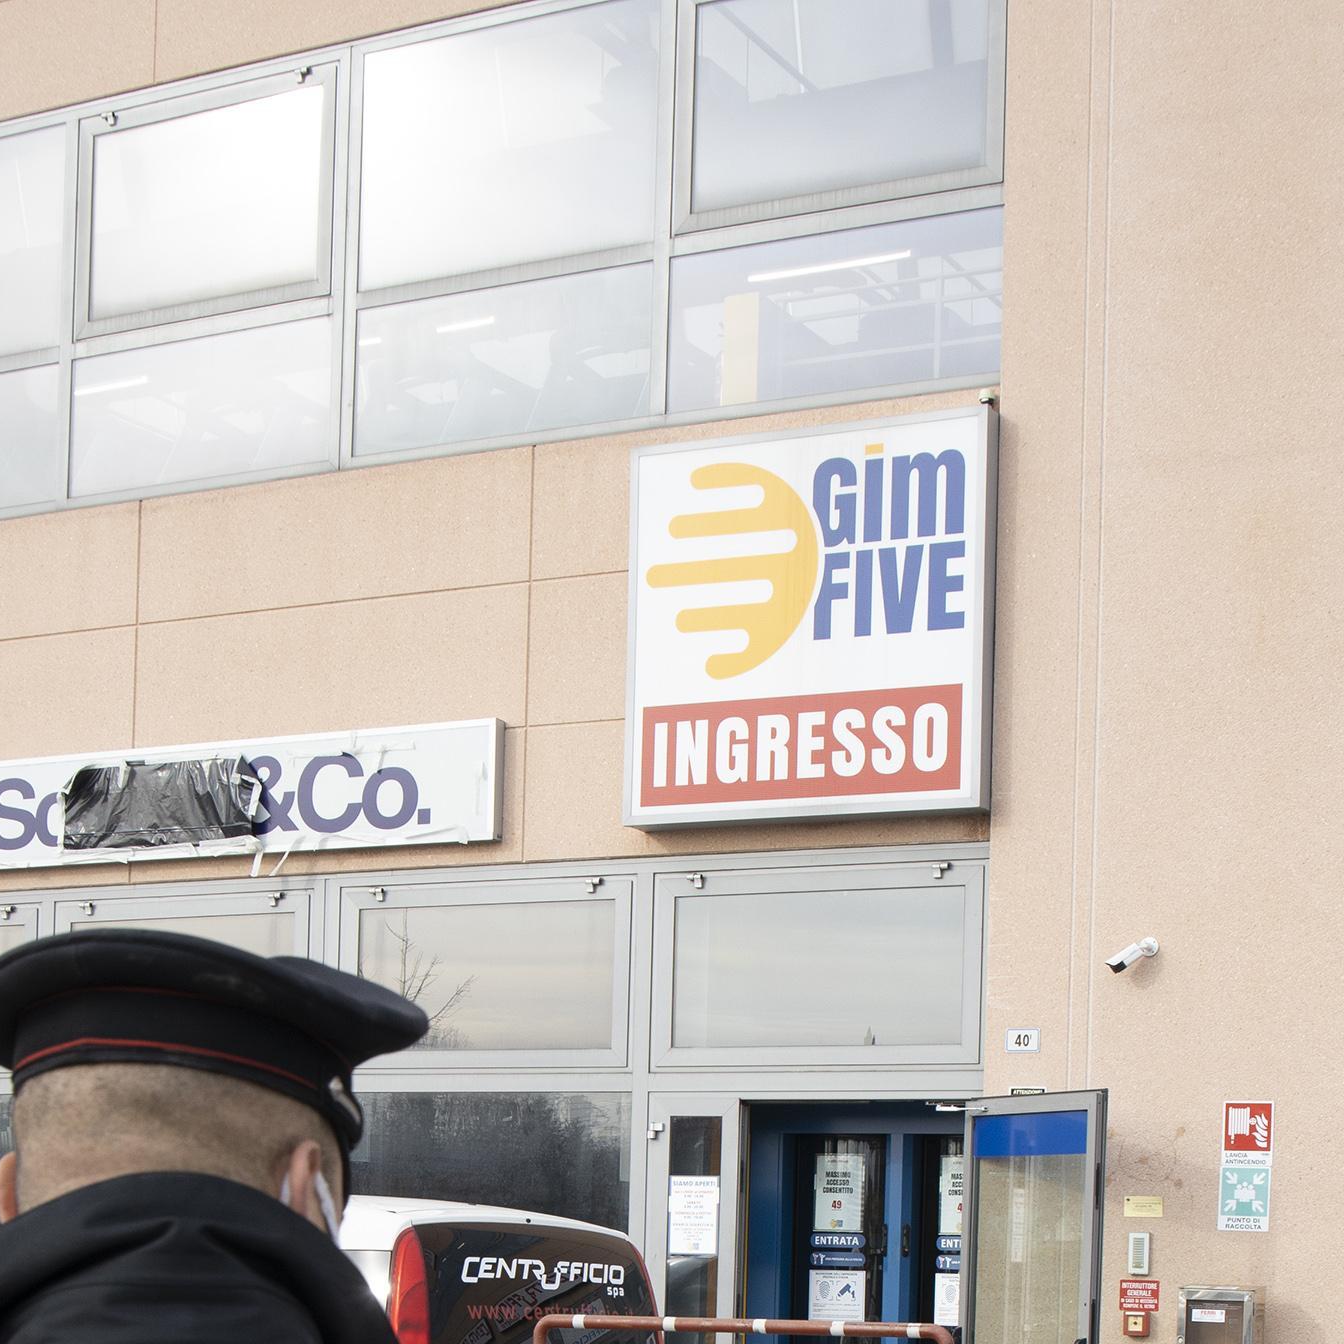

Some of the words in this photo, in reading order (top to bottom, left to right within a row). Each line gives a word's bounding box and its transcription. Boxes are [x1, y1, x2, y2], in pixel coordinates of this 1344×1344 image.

[812, 540, 966, 641] FIVE
[653, 702, 949, 788] INGRESSO
[831, 1200, 842, 1209] 49
[814, 1235, 860, 1246] ENTRATA
[607, 1286, 625, 1298] spa
